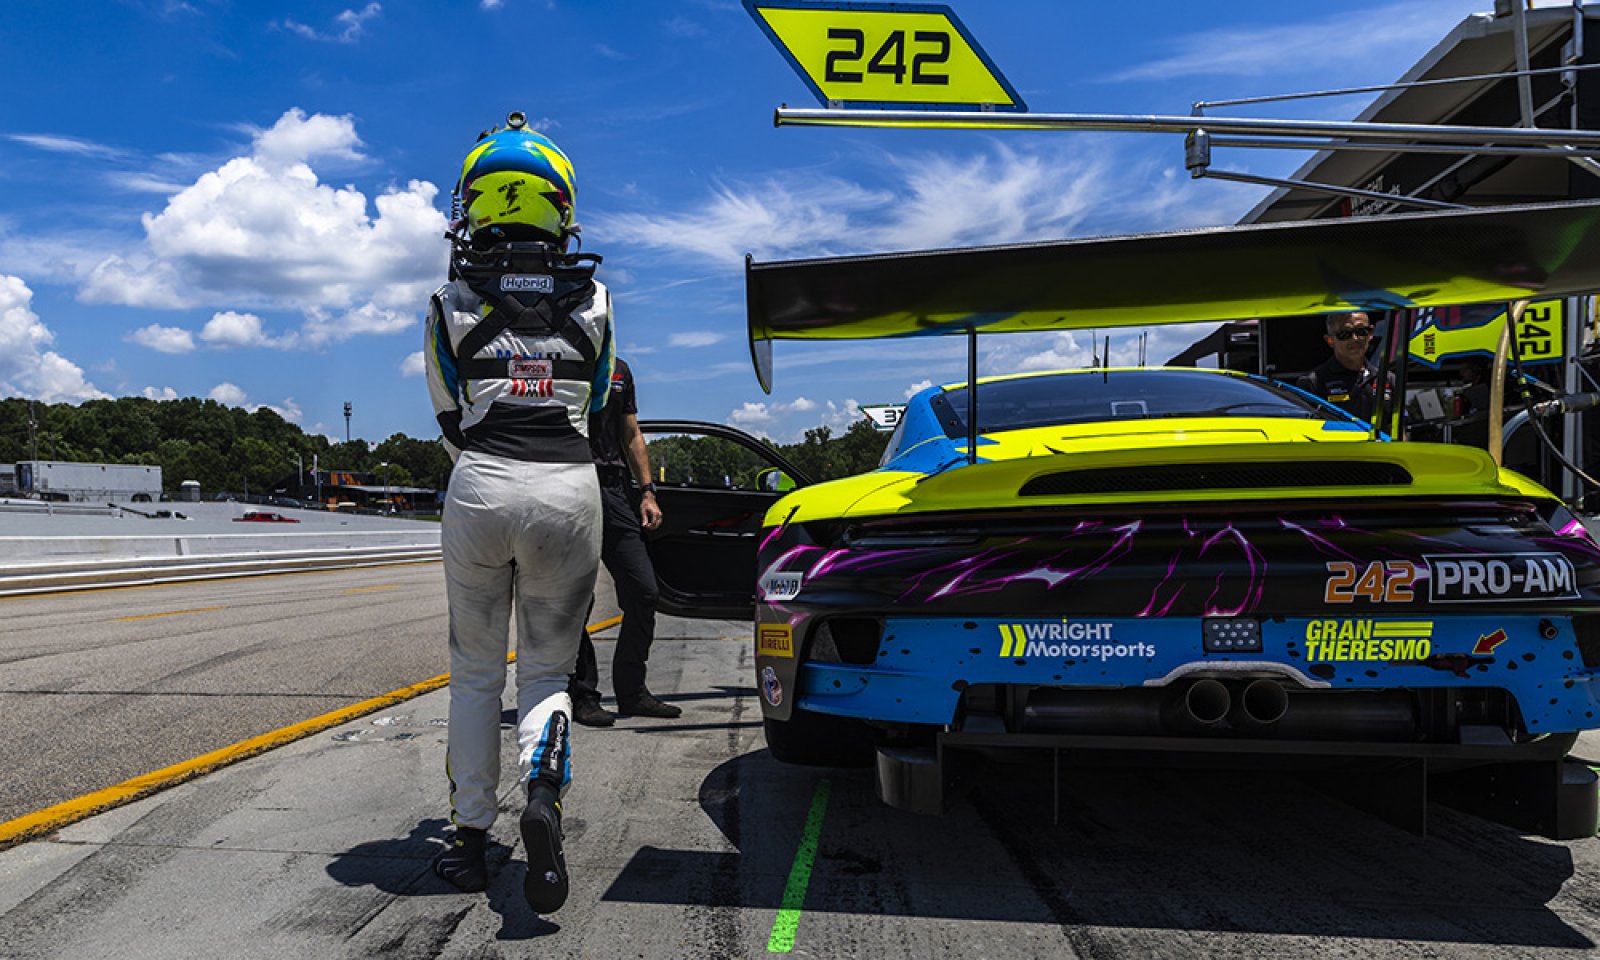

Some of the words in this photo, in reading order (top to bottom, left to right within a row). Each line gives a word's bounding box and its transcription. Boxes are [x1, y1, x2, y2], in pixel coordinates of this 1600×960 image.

[825, 28, 950, 85] 242
[505, 277, 548, 289] Hybrid
[1518, 306, 1551, 355] 242
[513, 364, 547, 374] SIMPSON
[1325, 561, 1415, 603] 242
[1435, 559, 1572, 595] PRO-AM
[1024, 618, 1113, 640] WRIGHT
[1306, 619, 1373, 641] GRAN
[761, 629, 790, 652] PIRELLI
[1025, 641, 1156, 662] Motorsports
[1305, 639, 1431, 662] THERESMO
